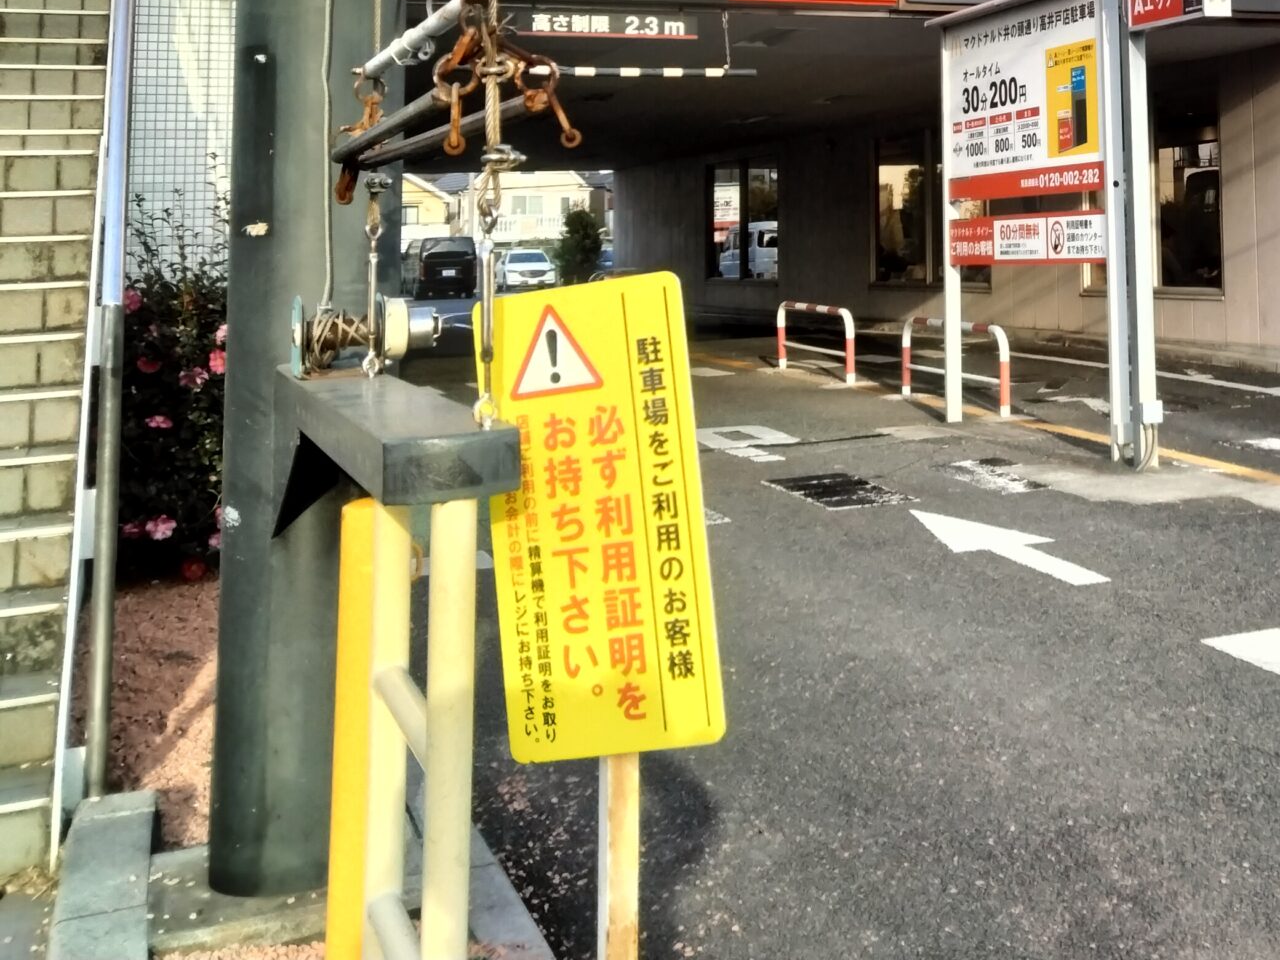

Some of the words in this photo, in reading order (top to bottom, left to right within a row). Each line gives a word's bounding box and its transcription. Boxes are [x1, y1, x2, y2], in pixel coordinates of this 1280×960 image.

[531, 13, 610, 33] 高さ制限
[963, 61, 1001, 82] オールタイム
[542, 412, 604, 698] お持ち下さい。
[587, 404, 647, 722] 必ず利用証明を
[635, 336, 696, 681] 駐車場をご利用のお客様
